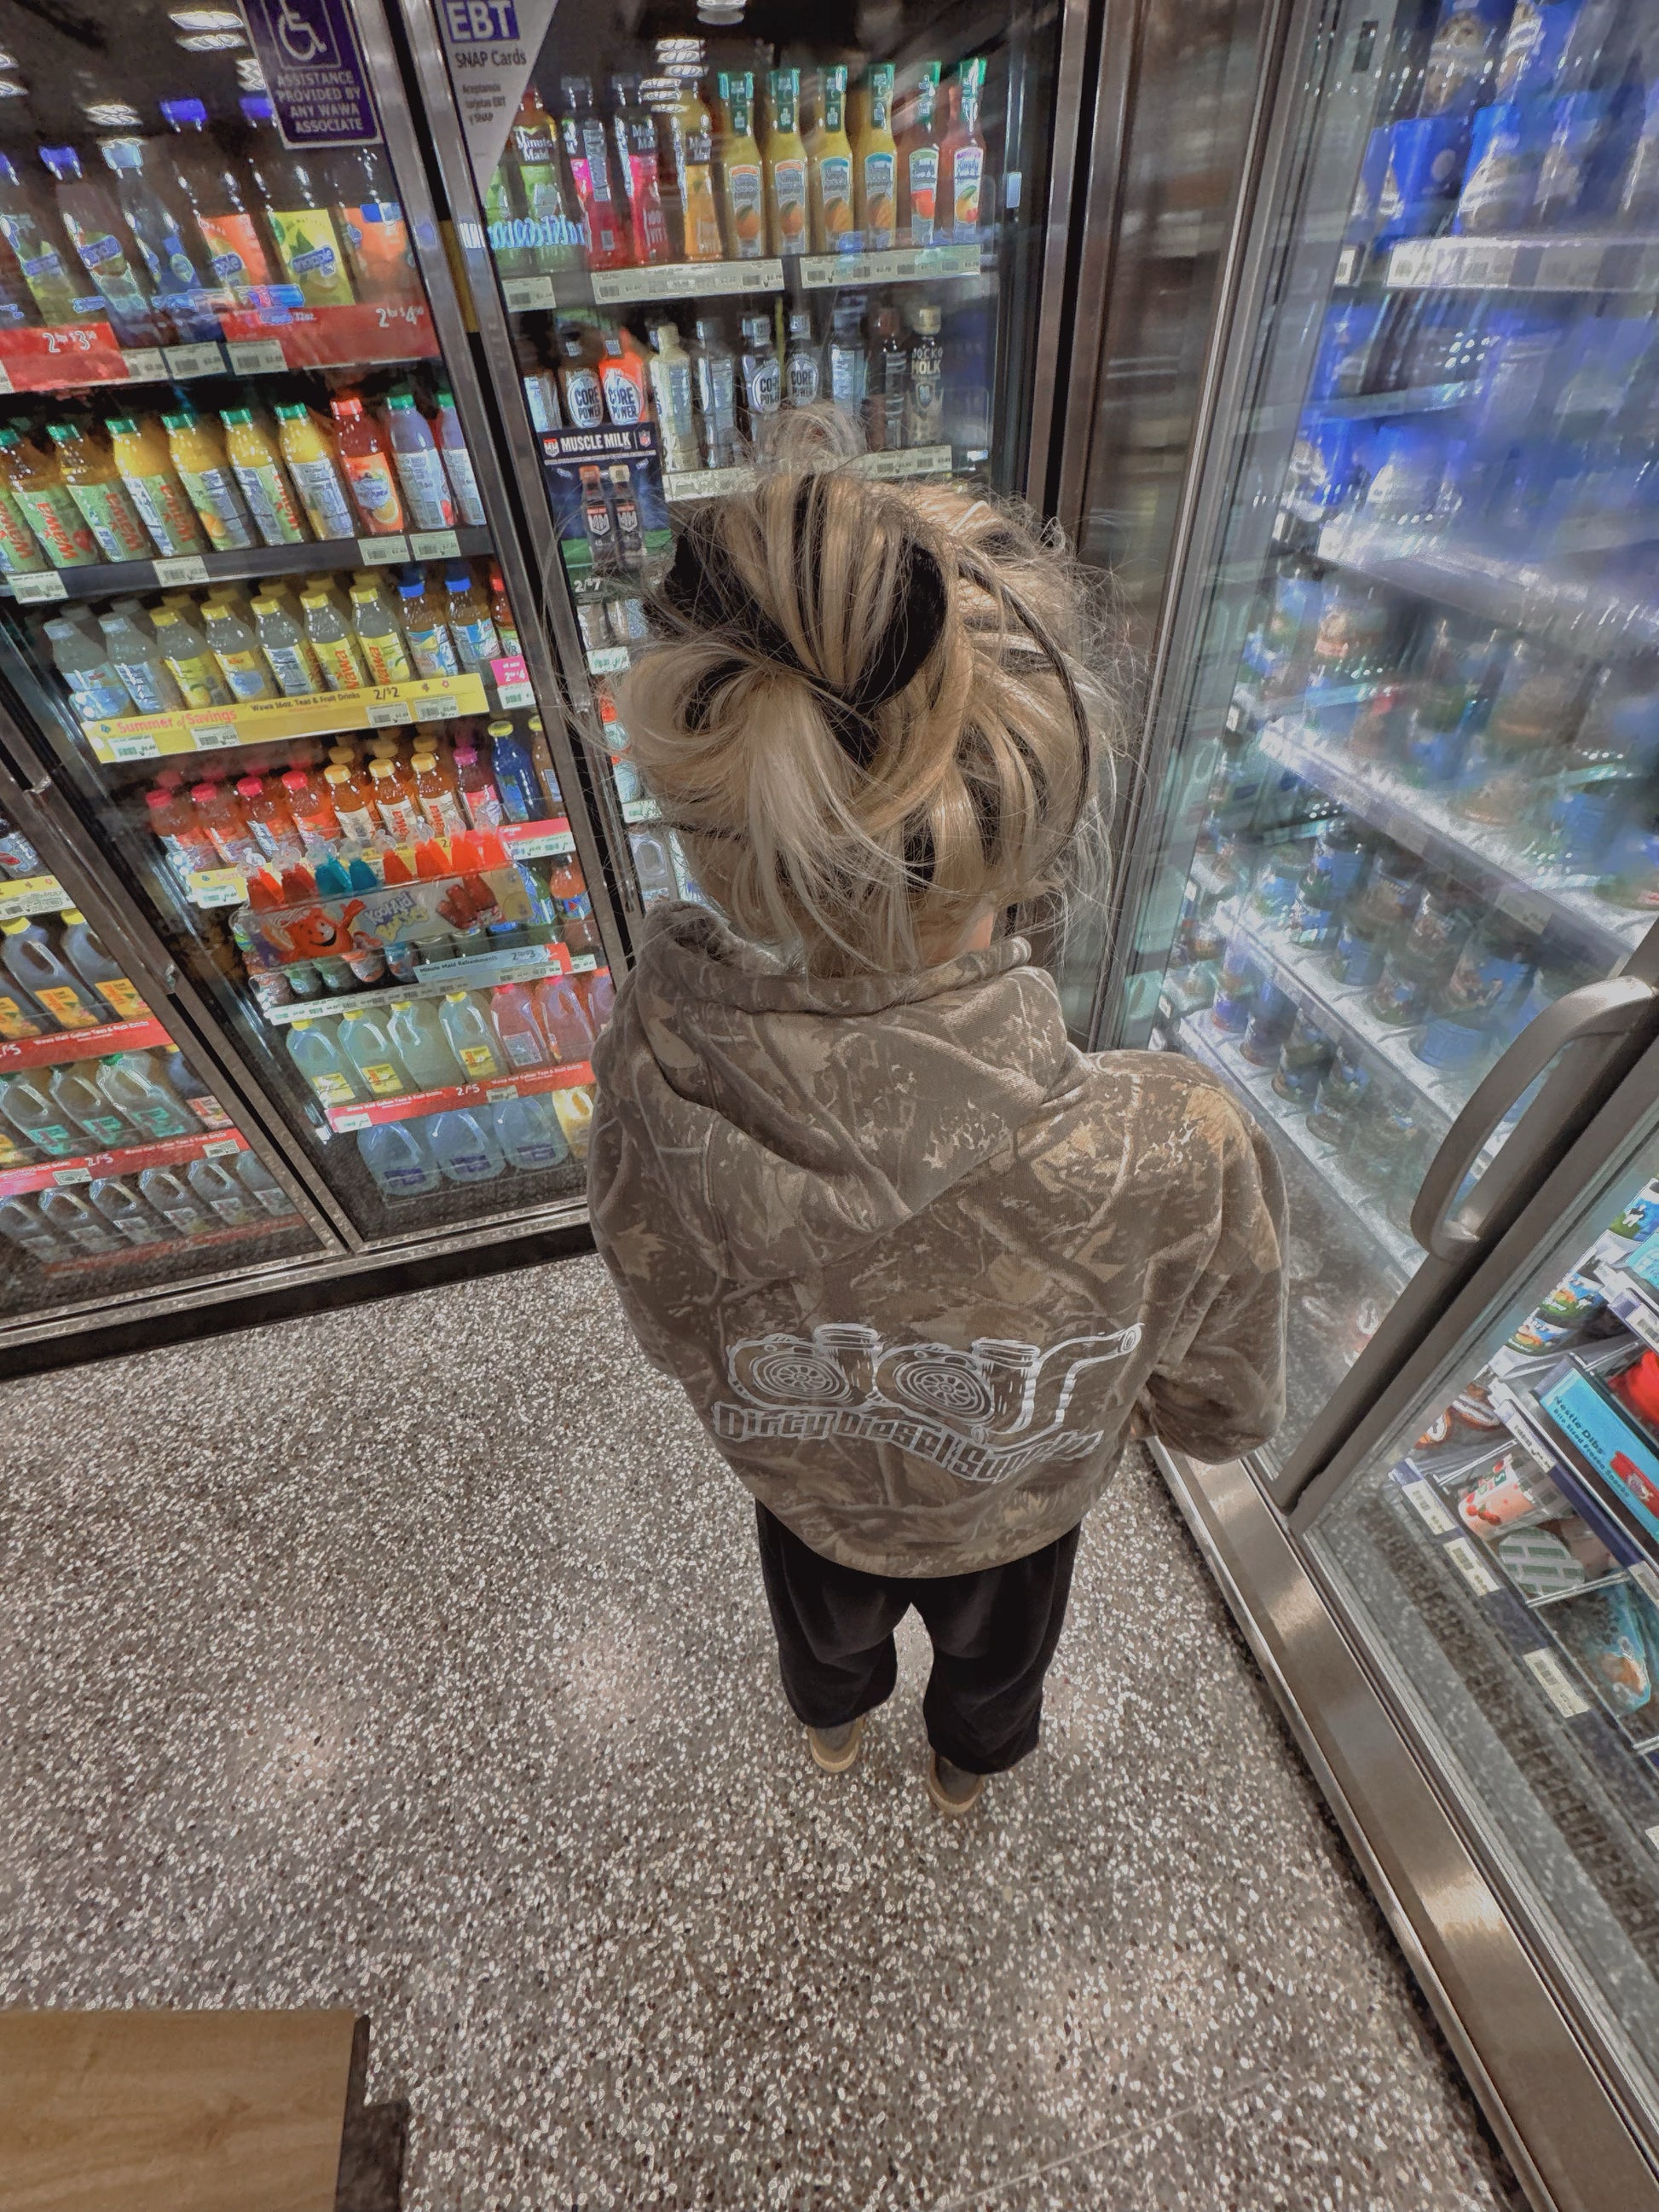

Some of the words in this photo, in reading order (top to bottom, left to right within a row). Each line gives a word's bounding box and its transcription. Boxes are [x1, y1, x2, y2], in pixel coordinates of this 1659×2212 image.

[446, 1, 512, 40] EBT
[455, 52, 488, 69] SNAP
[491, 48, 527, 66] Cards
[277, 70, 356, 86] ASSISTANCE
[275, 88, 342, 102] PROVIDED
[344, 86, 361, 100] BY
[291, 104, 315, 118] ANY
[317, 102, 361, 117] WAWA
[295, 118, 364, 133] ASSOCIATE
[376, 308, 390, 327] 2
[43, 332, 61, 353] 2
[573, 386, 598, 407] CORE
[605, 386, 633, 406] CORE
[560, 434, 604, 453] MUSCLE
[604, 431, 632, 449] MILK
[294, 697, 312, 707] Teas
[319, 693, 337, 704] Fruit
[338, 691, 361, 702] Drinks
[373, 685, 401, 701] 2/$2
[116, 716, 174, 734] Summer
[184, 709, 237, 725] Savings
[713, 1402, 834, 1441] Dirty
[832, 1408, 949, 1469] Diesel
[1553, 1395, 1582, 1430] Nestle
[1581, 1429, 1605, 1456] Dibs
